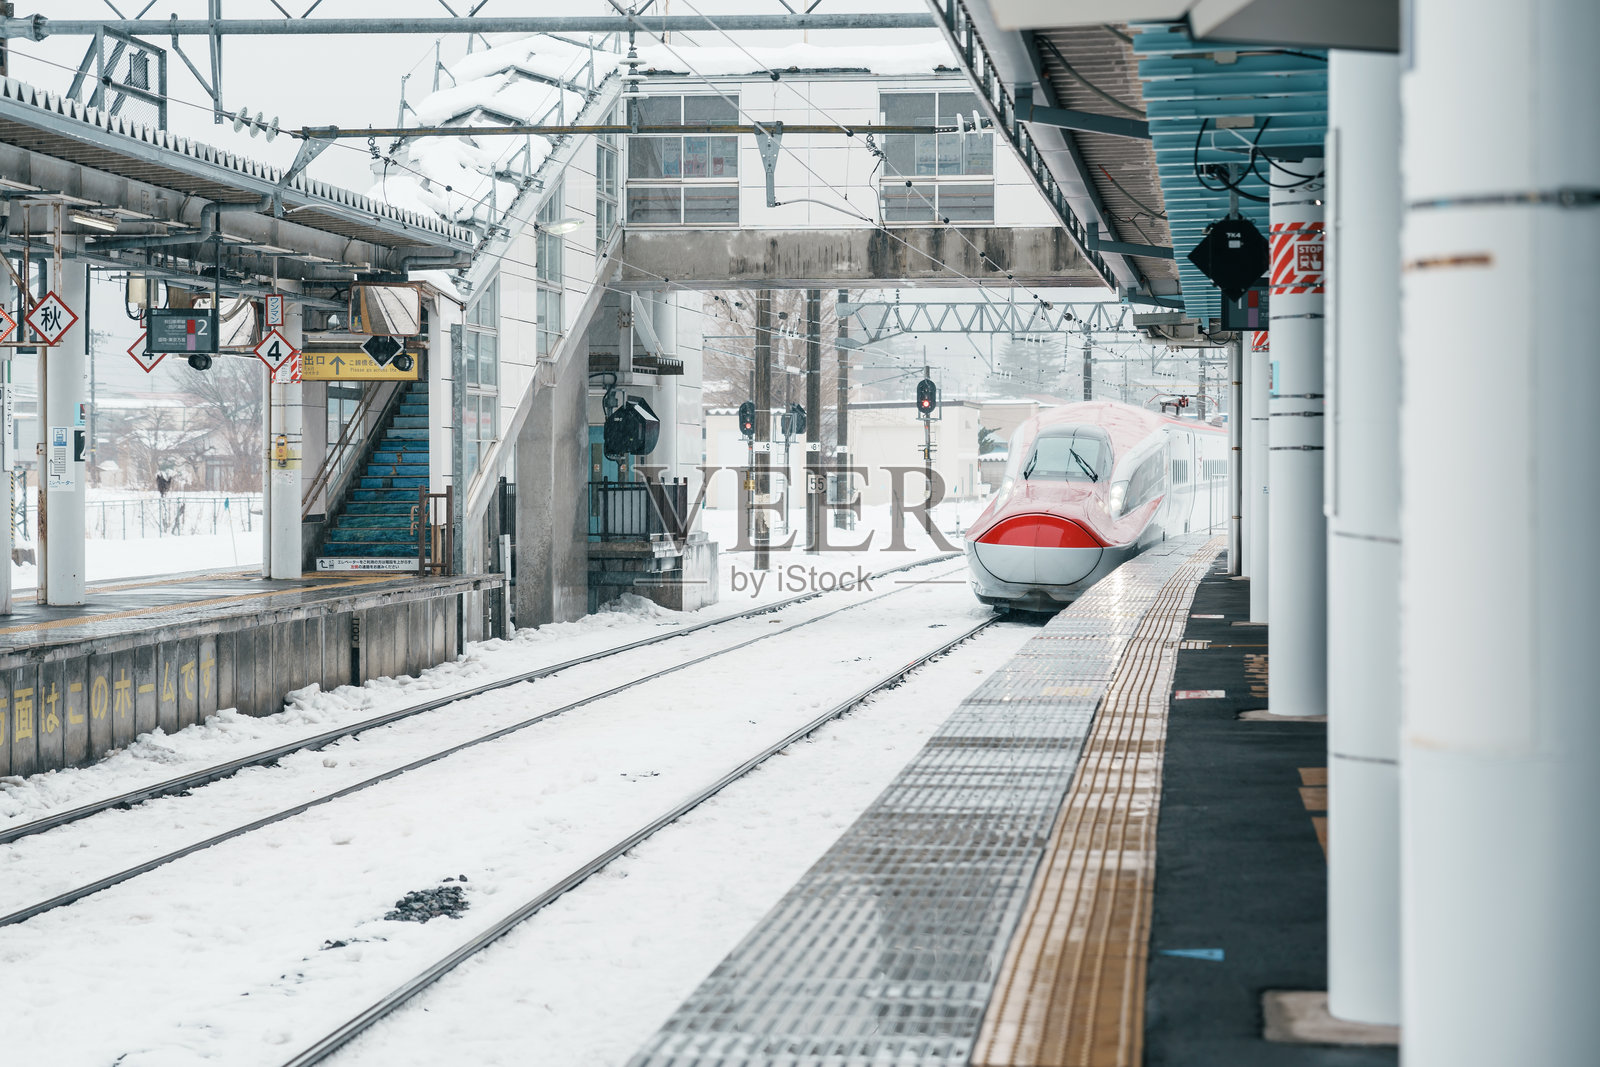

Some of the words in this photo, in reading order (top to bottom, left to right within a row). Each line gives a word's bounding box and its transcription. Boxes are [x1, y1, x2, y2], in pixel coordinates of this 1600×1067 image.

[40, 305, 62, 332] 秋
[270, 297, 279, 323] ワンマン
[197, 319, 208, 336] 2
[267, 340, 282, 362] 4
[304, 355, 325, 366] 出口
[810, 478, 824, 491] 55
